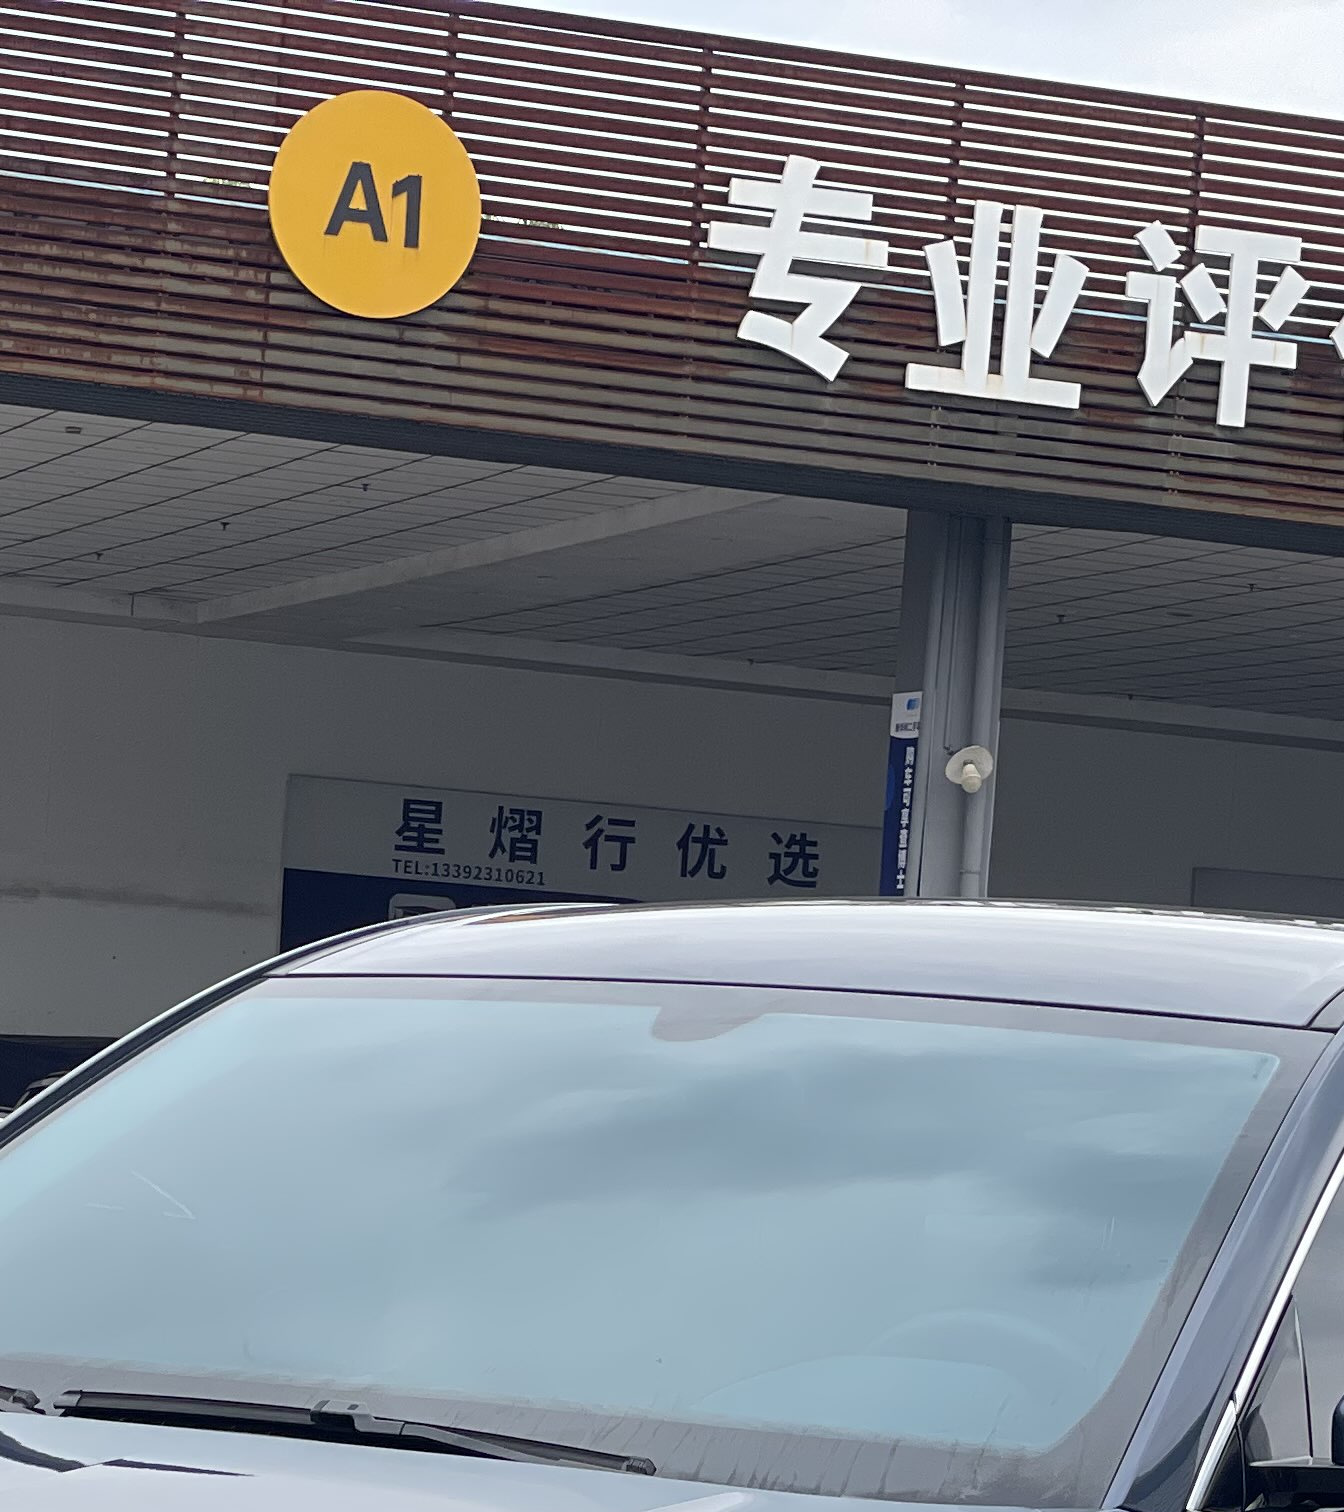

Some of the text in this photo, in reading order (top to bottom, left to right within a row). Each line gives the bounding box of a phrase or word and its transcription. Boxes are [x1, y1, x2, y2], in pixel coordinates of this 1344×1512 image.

[324, 160, 423, 249] A1
[391, 857, 546, 886] TEL:13392310621
[394, 798, 821, 889] 星熠行优选
